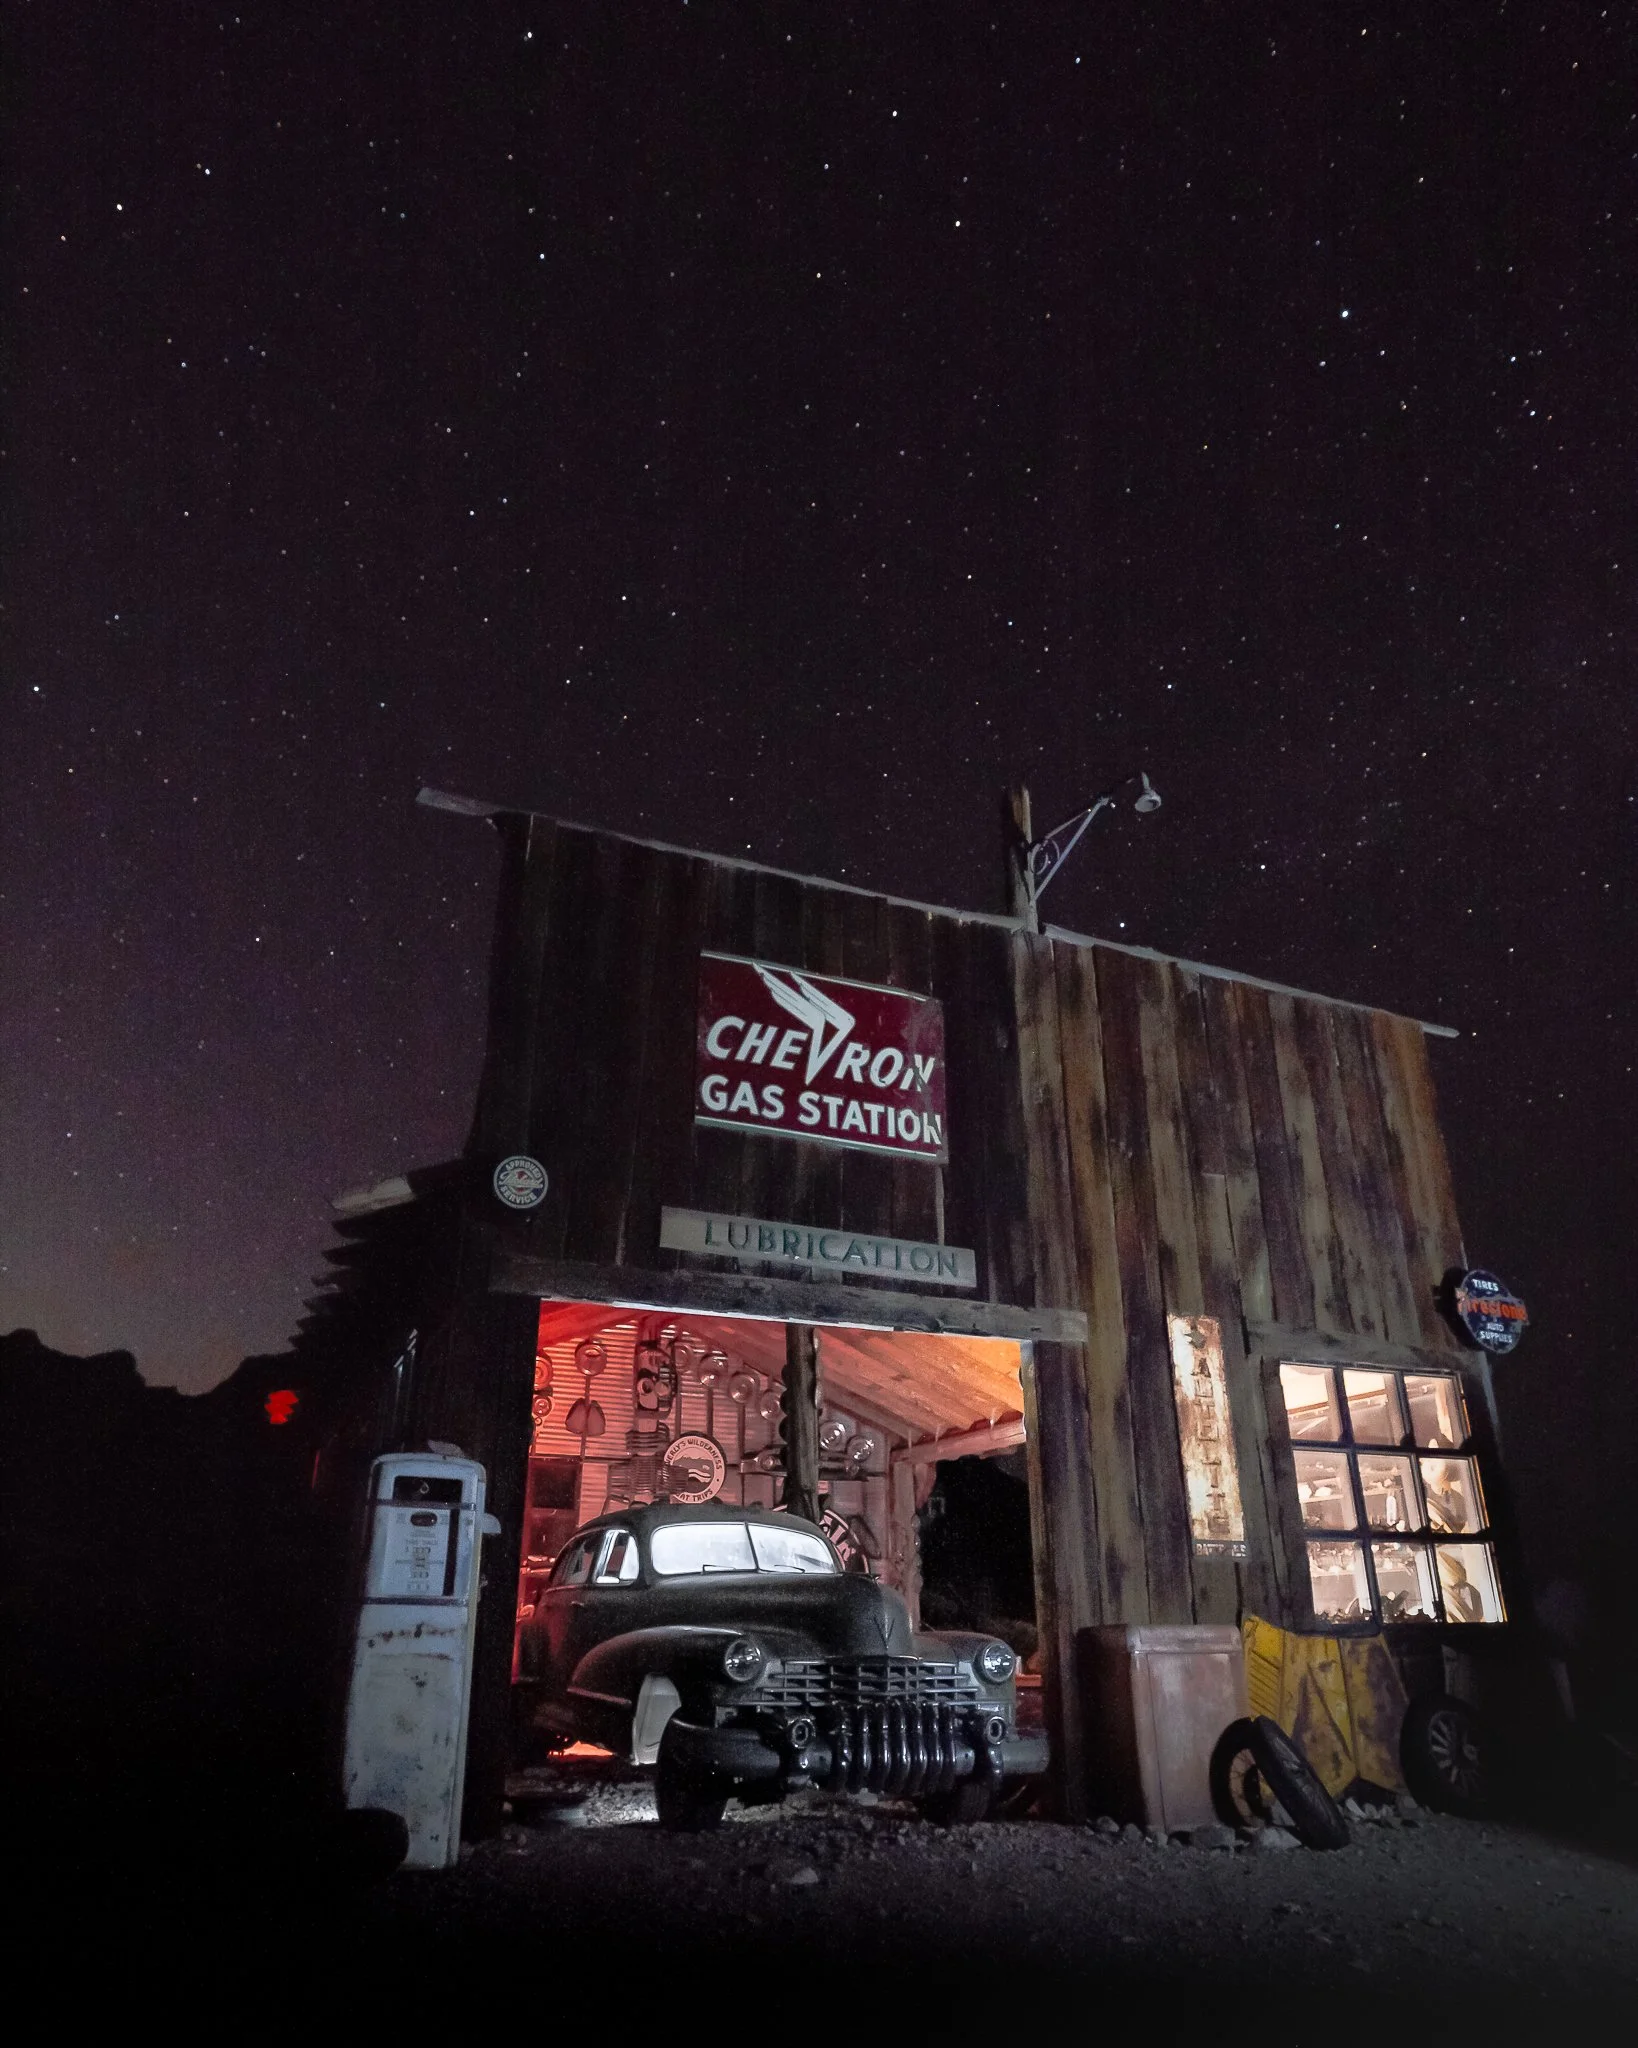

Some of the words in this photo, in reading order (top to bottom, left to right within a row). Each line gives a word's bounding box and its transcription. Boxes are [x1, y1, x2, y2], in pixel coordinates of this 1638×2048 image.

[705, 1006, 936, 1092] CHEVRON
[701, 1074, 785, 1120] GAS
[798, 1091, 942, 1144] STATION
[704, 1219, 959, 1277] LUBRICATION
[1472, 1278, 1499, 1292] TIRES
[1456, 1290, 1528, 1322] Firestone
[1480, 1331, 1513, 1343] SUPPLIES
[1487, 1323, 1504, 1332] AUTO
[692, 1489, 713, 1502] TRIPS
